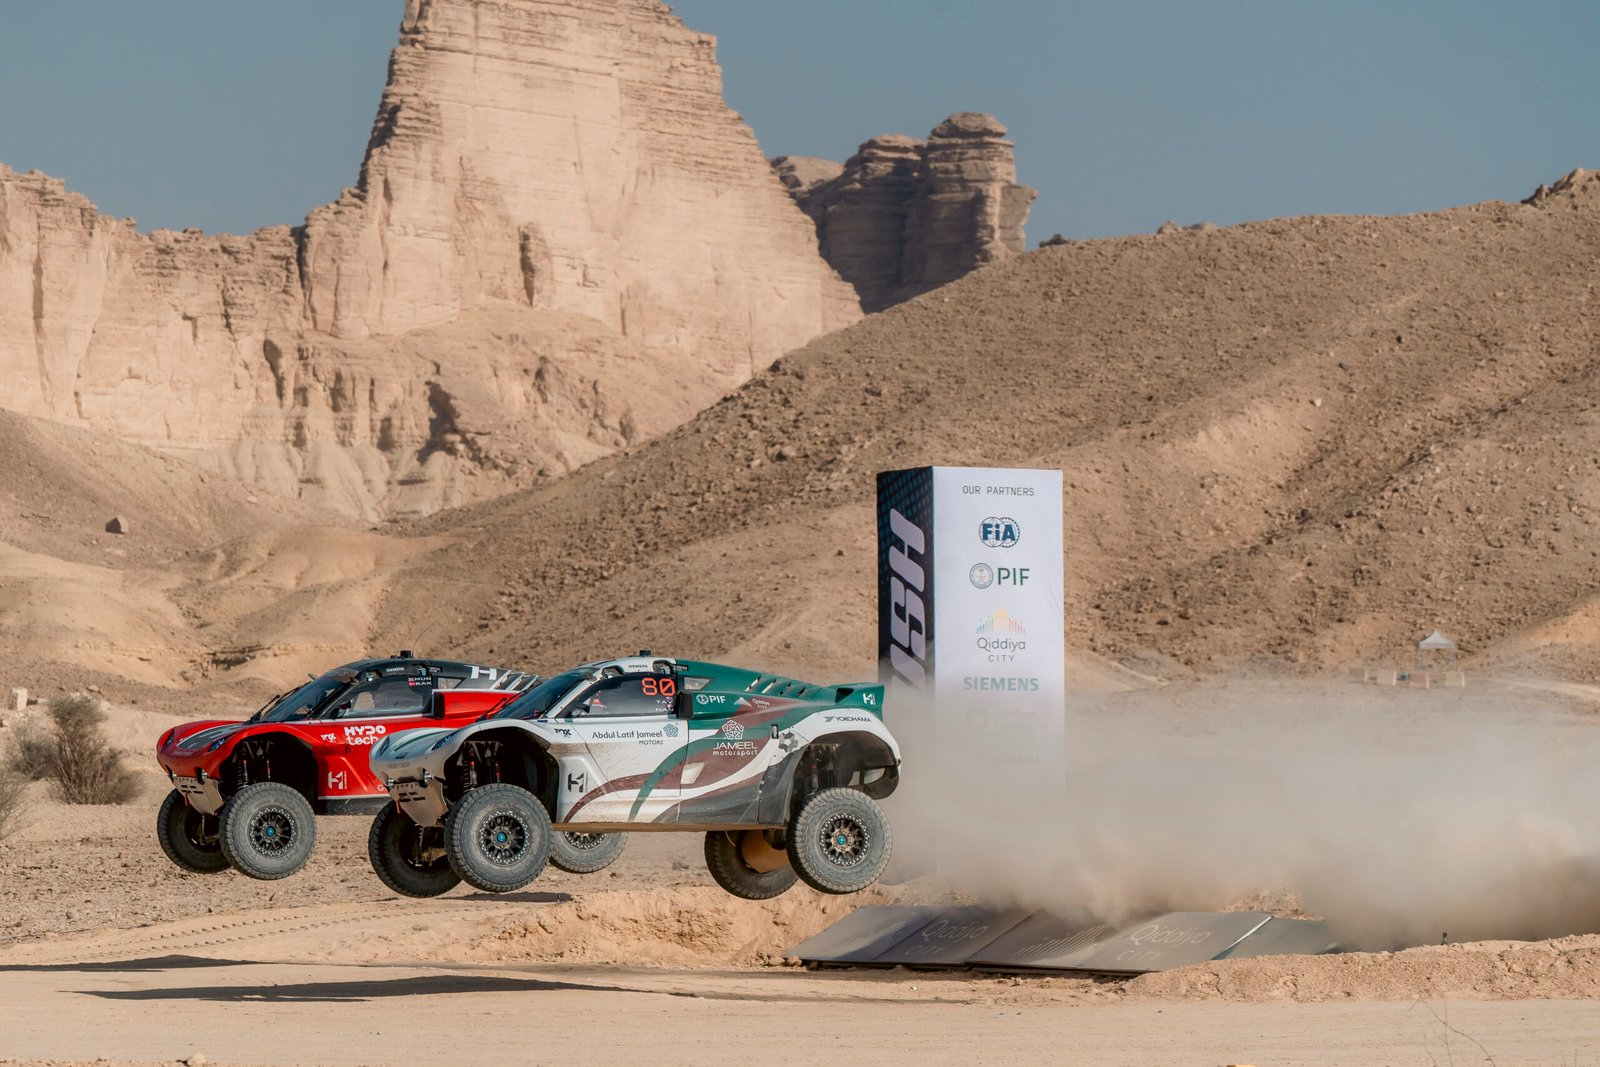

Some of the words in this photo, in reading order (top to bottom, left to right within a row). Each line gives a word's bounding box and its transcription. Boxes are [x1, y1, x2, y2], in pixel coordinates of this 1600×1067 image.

[962, 485, 981, 495] OUR
[987, 486, 1035, 497] PARTNERS
[997, 567, 1030, 586] PIF
[976, 637, 1026, 652] Qiddiya
[988, 654, 1016, 663] CITY
[642, 677, 675, 696] 80
[963, 676, 1039, 692] SIEMENS
[709, 696, 726, 704] PIF
[616, 731, 635, 739] Latif
[636, 730, 663, 739] Jameel
[713, 741, 758, 750] JAMEEL
[712, 749, 758, 757] motorsport
